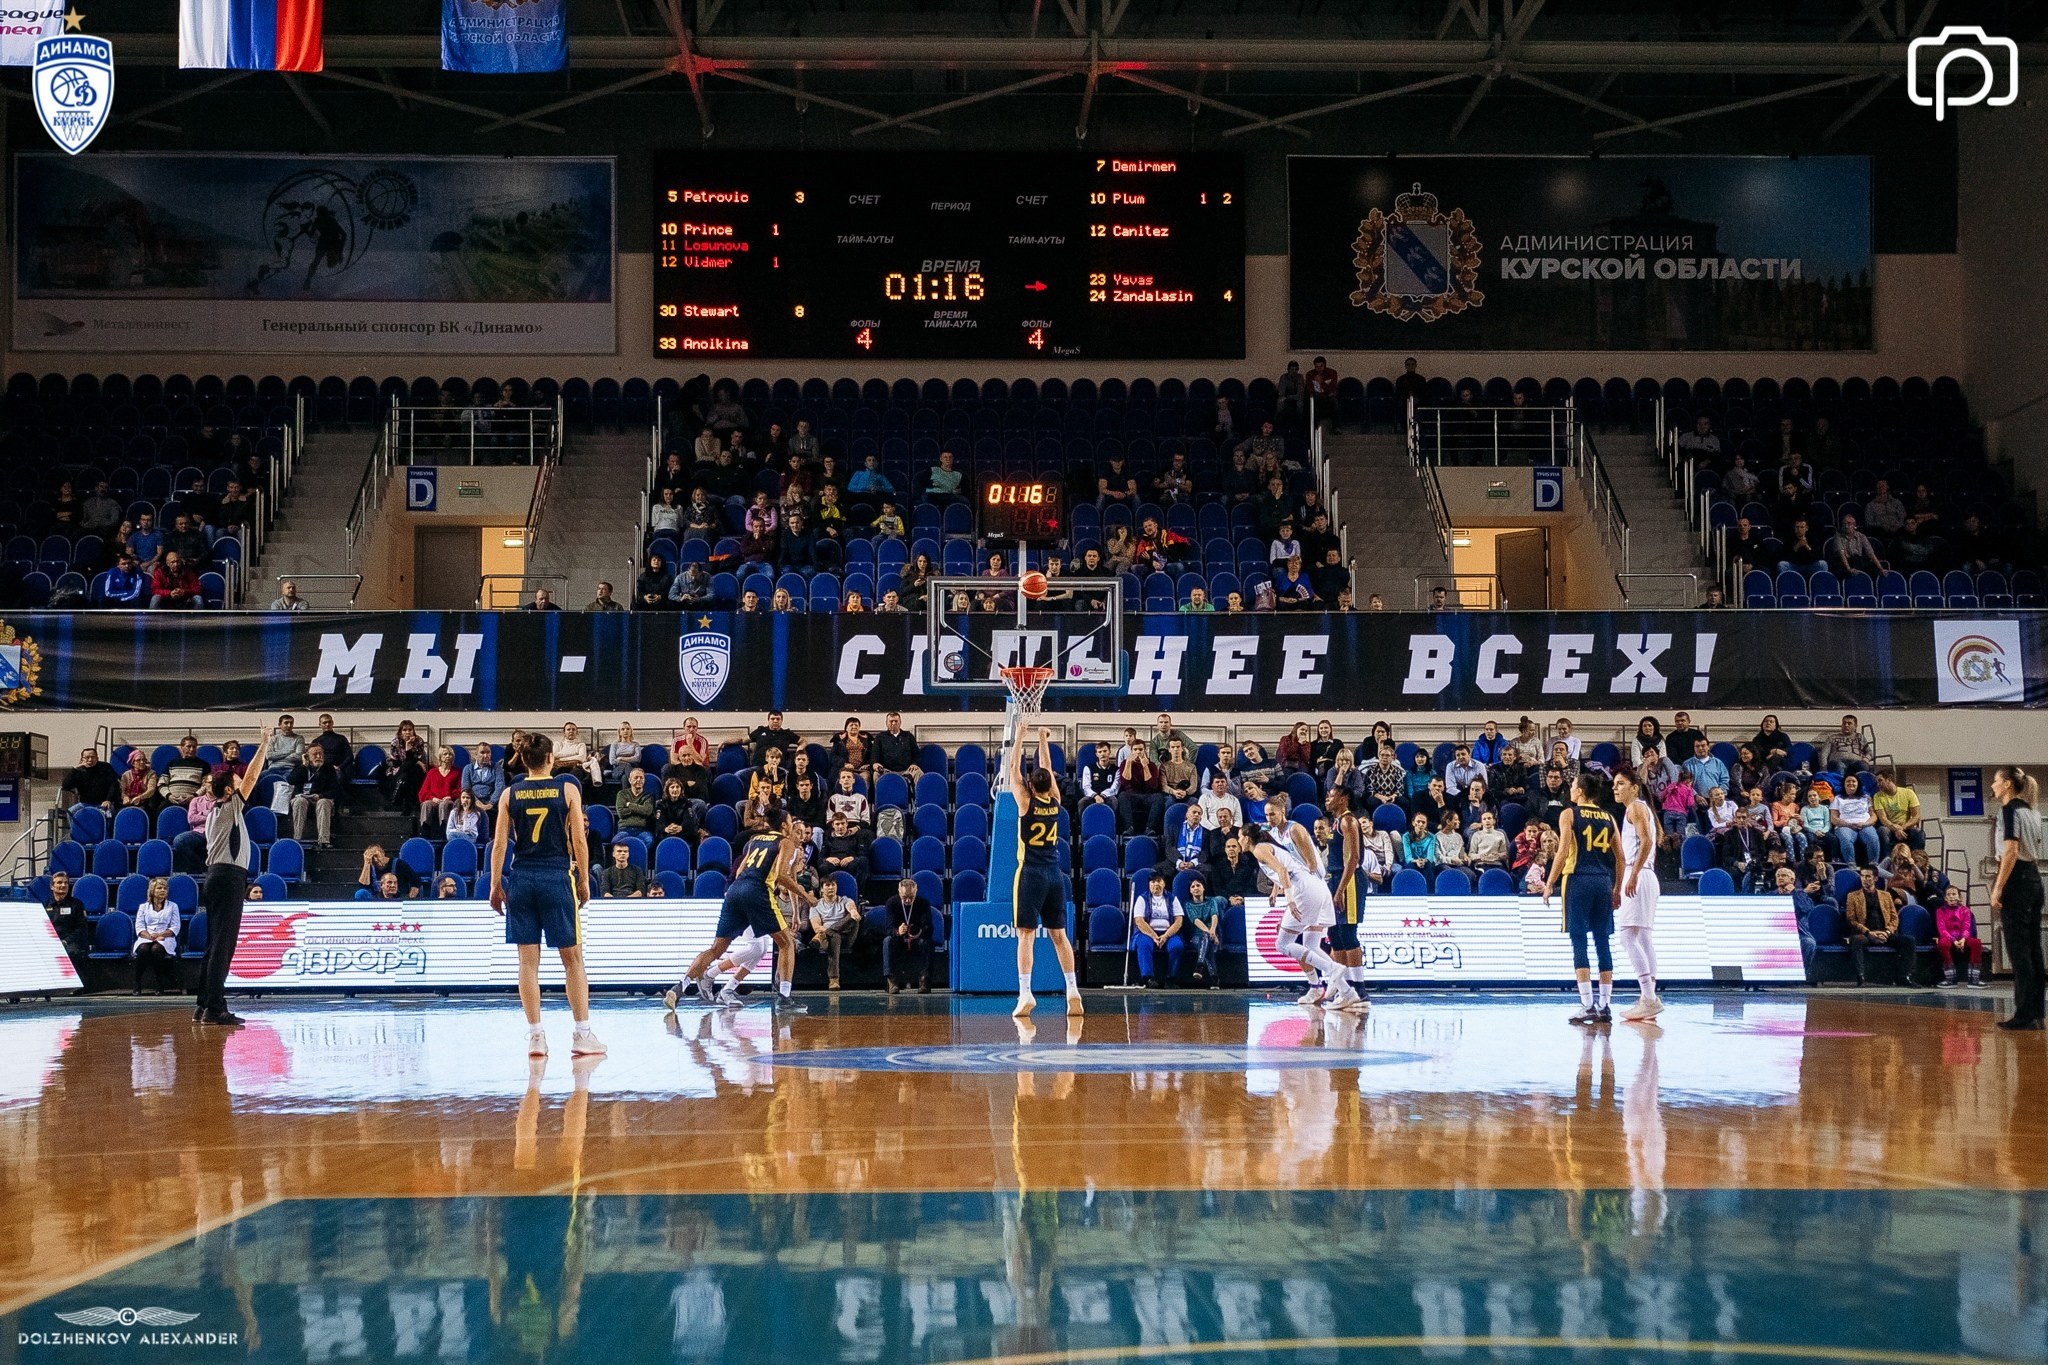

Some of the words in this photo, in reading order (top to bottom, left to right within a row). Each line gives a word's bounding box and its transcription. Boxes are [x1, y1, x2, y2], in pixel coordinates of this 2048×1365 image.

[1096, 160, 1105, 172] 7
[1112, 160, 1176, 172] Demirmen
[668, 191, 677, 203] 5
[684, 191, 749, 203] Petrovic
[795, 192, 805, 203] 3
[849, 195, 881, 205] СЧЕТ
[1016, 195, 1048, 206] СЧЕТ
[1090, 193, 1106, 205] 10
[1112, 193, 1145, 205] Plum
[1200, 193, 1207, 205] 1
[1223, 193, 1232, 205] 2
[930, 202, 971, 212] ПЕРИОД
[661, 223, 677, 236] 10
[684, 223, 733, 236] Prince
[773, 224, 780, 236] 1
[1090, 225, 1106, 237] 12
[1112, 225, 1169, 237] Canitez
[662, 240, 676, 251] 11
[837, 235, 894, 244] ТАЙМ-АУТЫ
[1008, 235, 1065, 245] ТАЙМ-АУТЫ
[1500, 235, 1693, 252] АДМИНИСТРАЦИЯ
[662, 256, 677, 268] 12
[684, 256, 733, 268] Vidmer
[773, 257, 780, 268] 1
[921, 260, 981, 273] ВРЕМЯ
[1501, 253, 1645, 280] КУРСКОЙ
[1653, 257, 1800, 280] ОБЛАСТИ
[885, 273, 984, 300] 01:16
[1089, 274, 1106, 286] 23
[1113, 274, 1154, 286] Yavas
[1089, 290, 1106, 302] 24
[1113, 290, 1193, 302] Zandalasin
[1223, 290, 1233, 302] 4
[660, 305, 677, 317] 30
[684, 305, 740, 317] Stewart
[795, 305, 805, 317] 8
[933, 311, 968, 319] ВРЕМЯ
[262, 318, 367, 335] Генеральный
[371, 321, 436, 336] спонсор
[439, 320, 460, 334] БК
[464, 321, 543, 336] «Динамо»
[850, 319, 881, 328] ФОЛЫ
[924, 319, 978, 328] ТАЙМ-АУТА
[1021, 319, 1052, 328] ФОЛЫ
[660, 337, 677, 350] 33
[683, 337, 749, 350] Anoikina
[856, 328, 873, 350] 4
[1028, 328, 1045, 350] 4
[409, 478, 434, 507] D
[1536, 479, 1561, 508] D
[684, 635, 727, 649] ДИНАМО
[309, 634, 484, 694] МЫ
[1402, 633, 1718, 694] ВСЕХ!
[1954, 780, 1977, 812] F
[1580, 809, 1611, 822] SOTTANA
[526, 808, 549, 843] 7
[1029, 821, 1058, 846] 24
[1582, 825, 1610, 853] 14
[747, 847, 768, 868] 41
[978, 922, 1048, 938] moln
